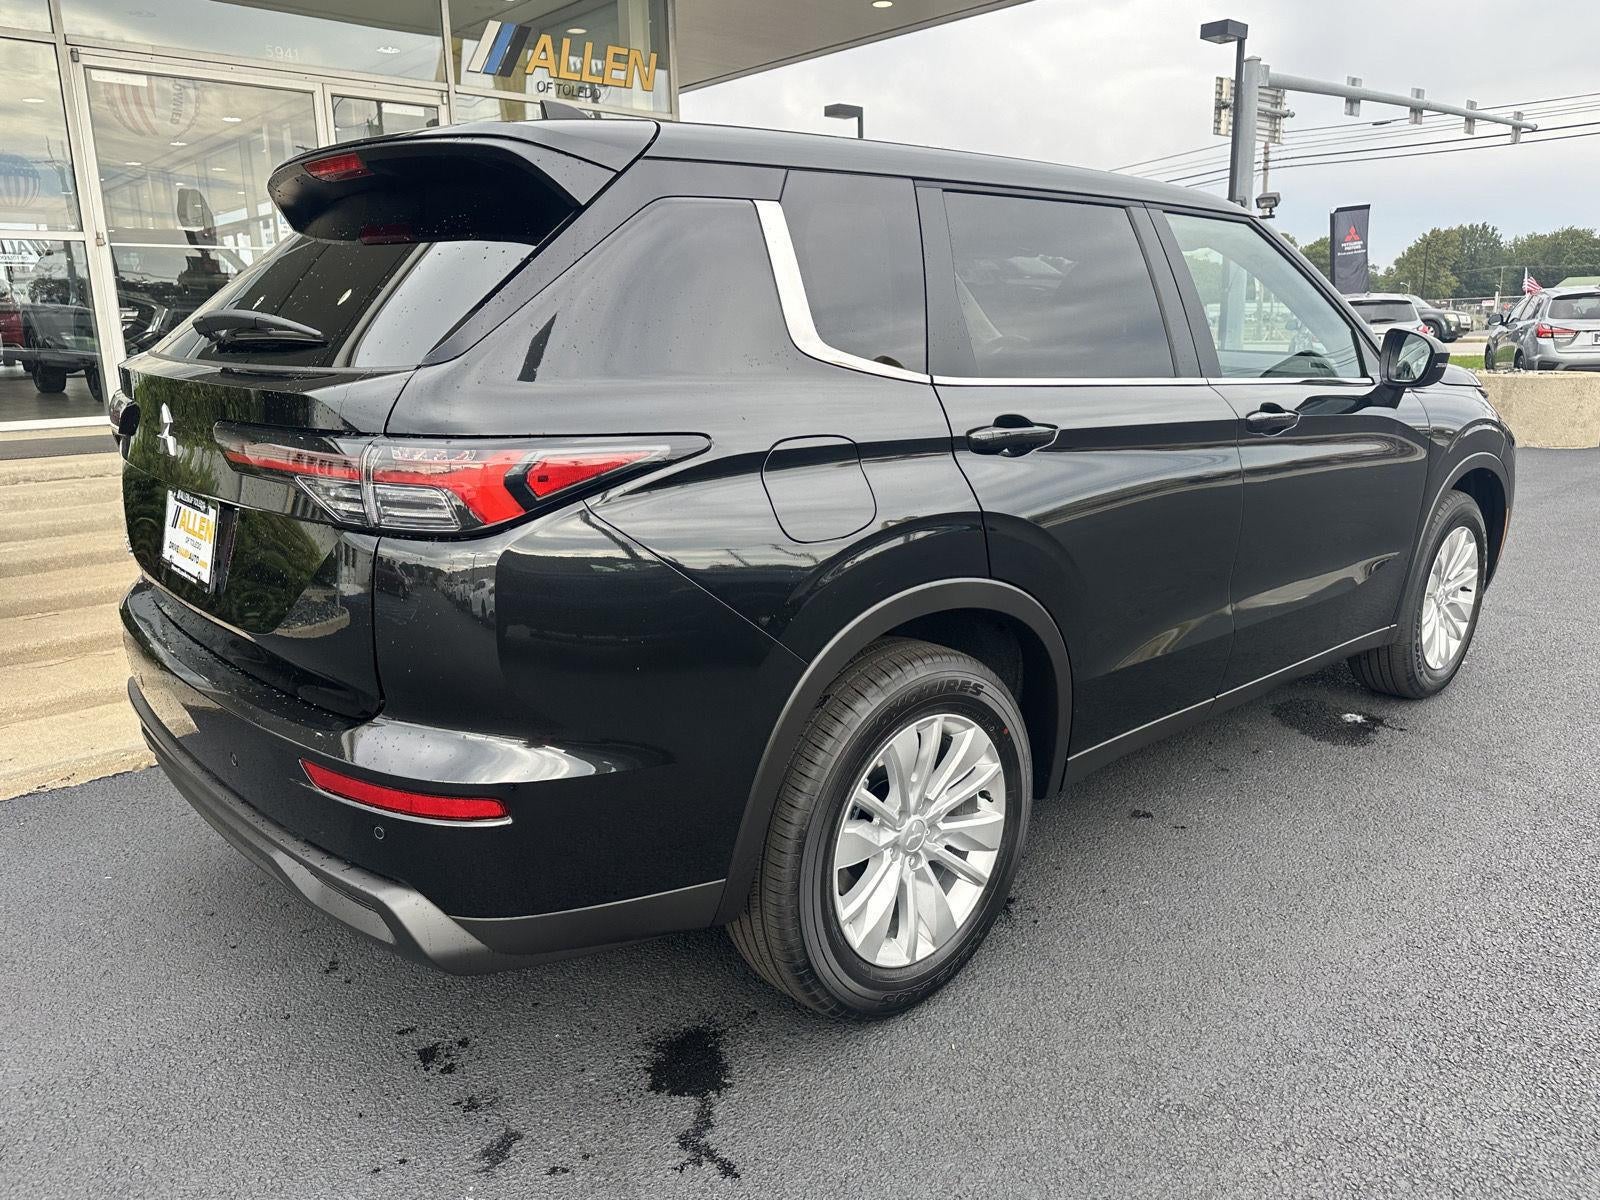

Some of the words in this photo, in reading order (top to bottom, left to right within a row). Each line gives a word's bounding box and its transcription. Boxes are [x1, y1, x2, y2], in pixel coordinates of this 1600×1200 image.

[265, 45, 298, 58] 5941
[525, 34, 657, 92] ALLEN
[537, 80, 553, 93] OF
[556, 83, 601, 99] TOLEDO
[179, 508, 214, 544] ALLEN
